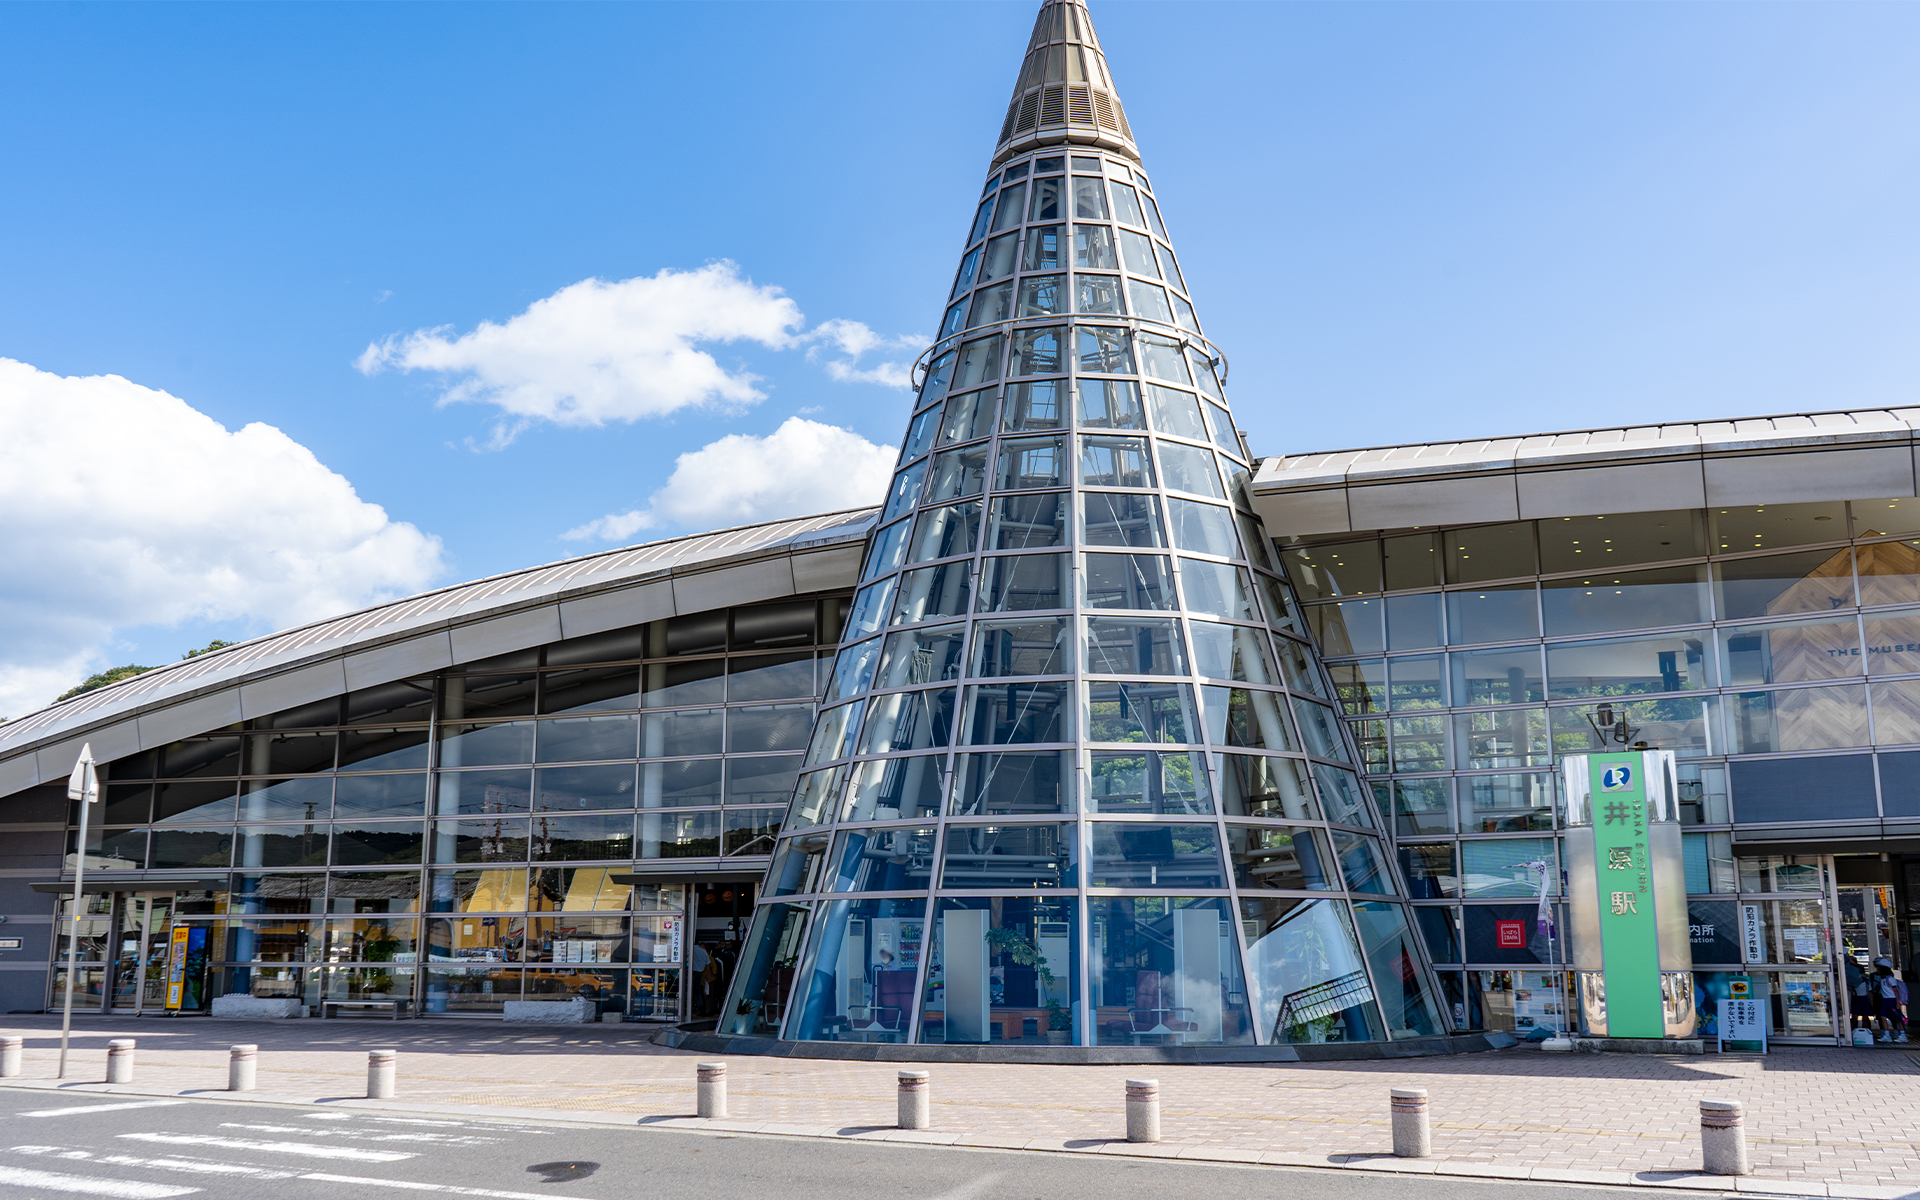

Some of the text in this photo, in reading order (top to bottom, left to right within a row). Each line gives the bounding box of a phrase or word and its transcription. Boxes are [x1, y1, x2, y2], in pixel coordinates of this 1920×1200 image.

[1827, 643, 1920, 657] THE MUSE
[1604, 801, 1638, 915] 井原駅
[1633, 800, 1648, 893] IBARA STATION
[1689, 924, 1715, 936] 内所
[1746, 906, 1758, 960] 防犯カメラ作動中
[1728, 1001, 1736, 1039] 置かないで下さい
